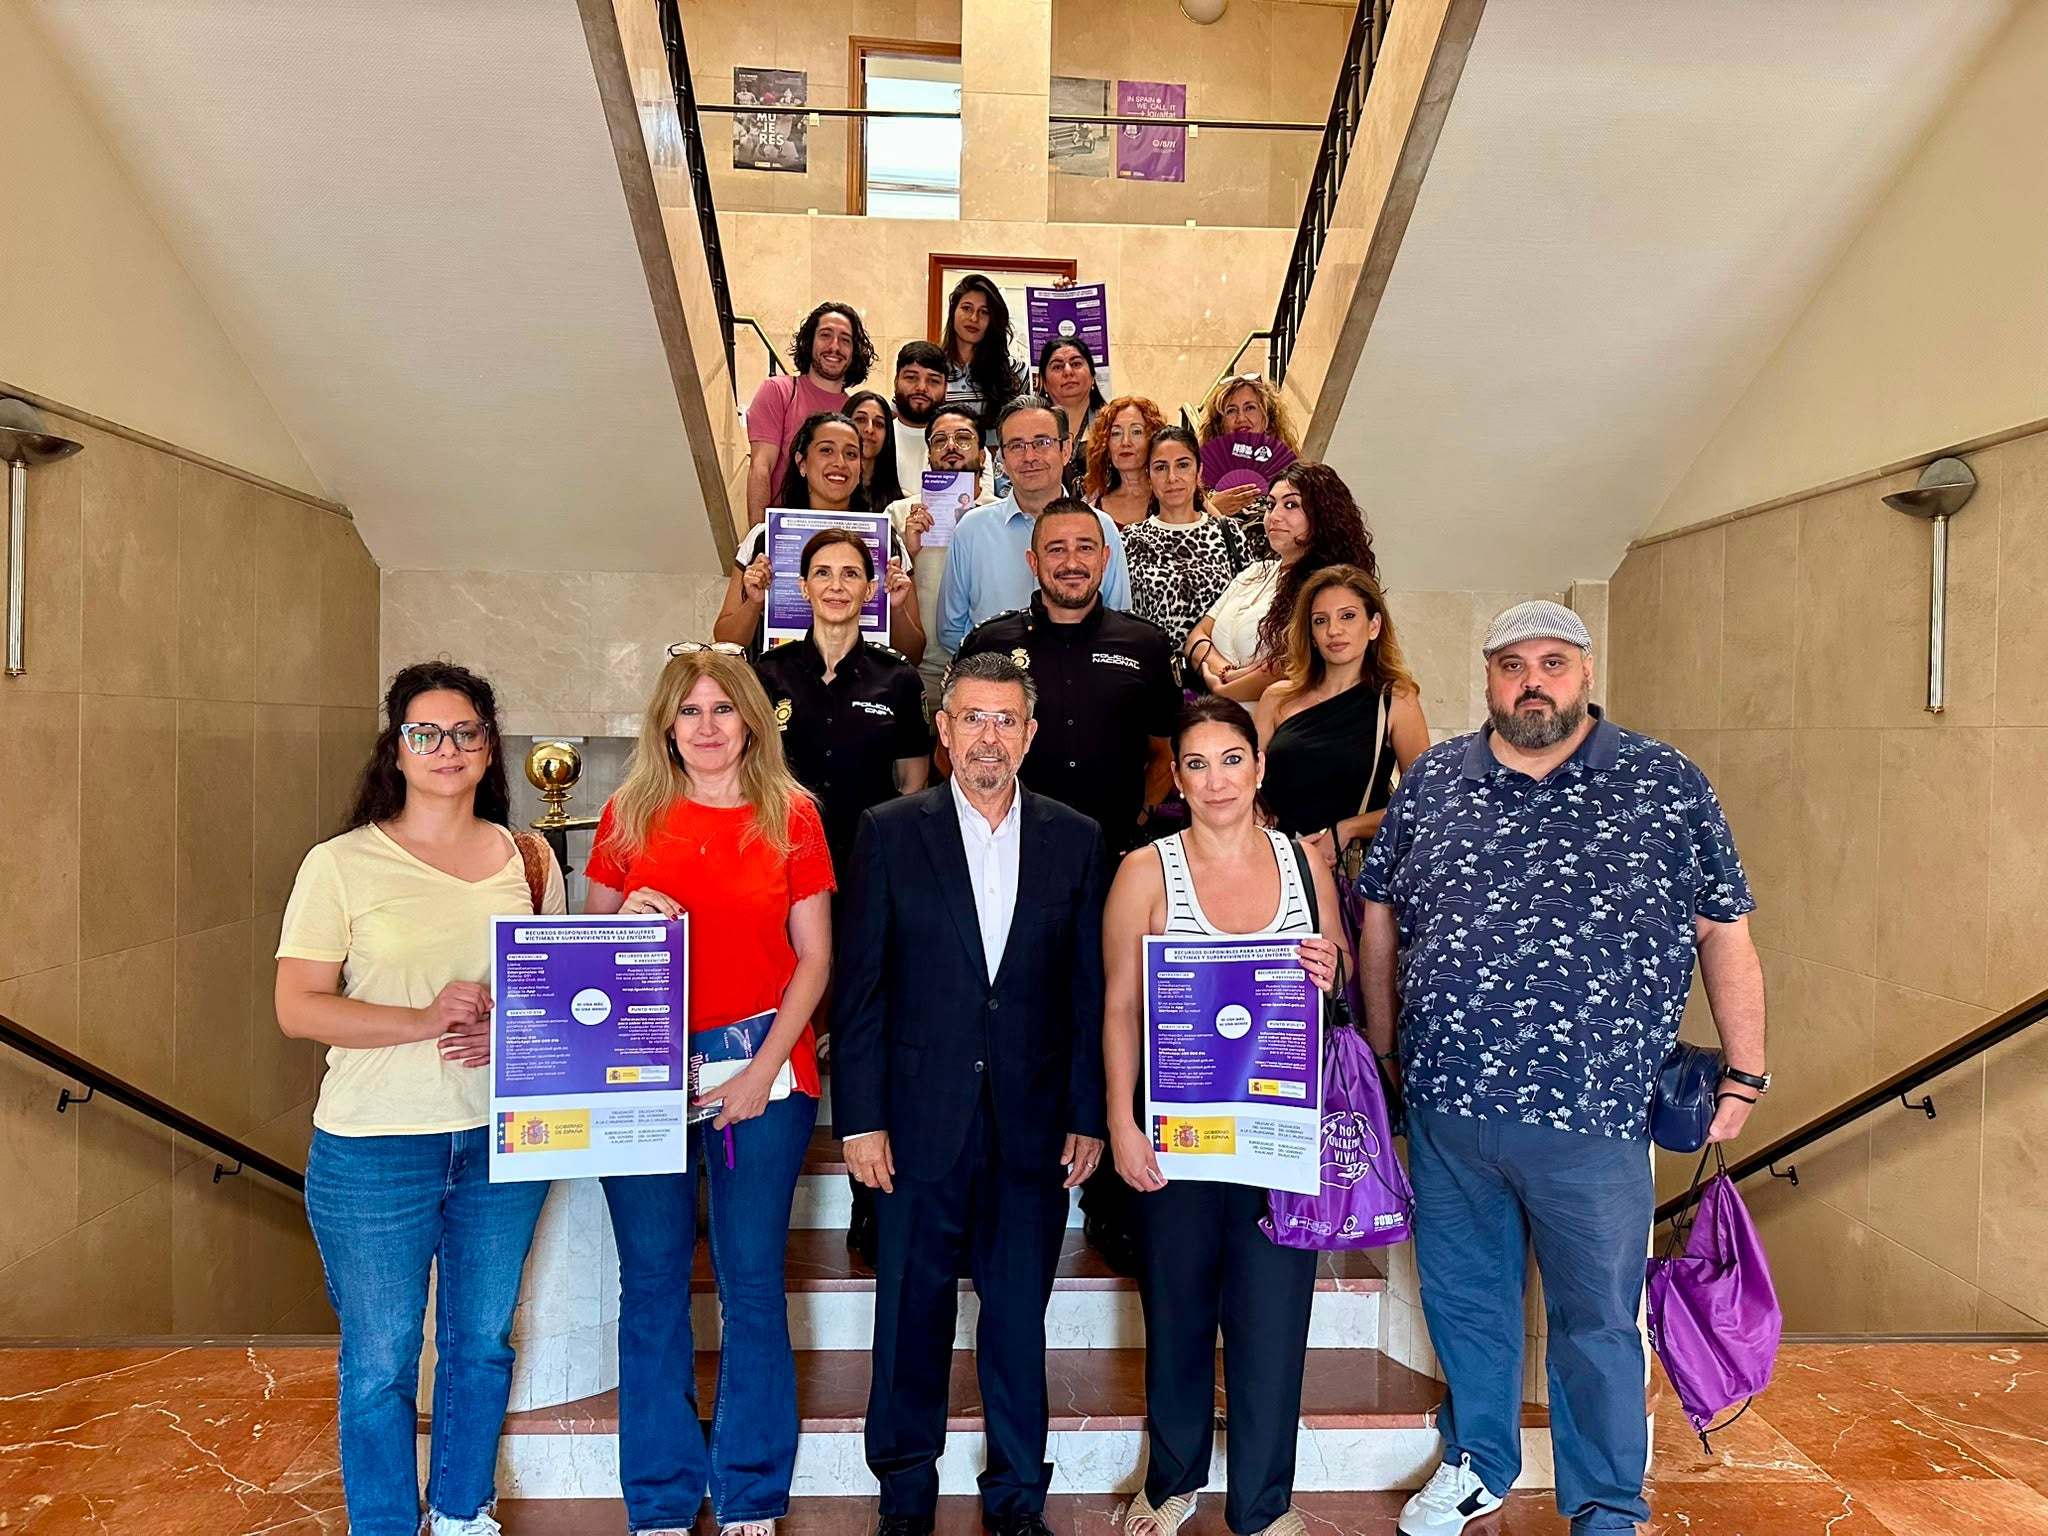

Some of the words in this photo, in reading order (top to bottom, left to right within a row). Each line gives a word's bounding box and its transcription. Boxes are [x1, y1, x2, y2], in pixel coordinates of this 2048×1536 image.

[761, 122, 776, 134] JE
[760, 134, 784, 146] RES
[1092, 658, 1140, 670] NACIONAL
[1340, 1124, 1356, 1137] NOS
